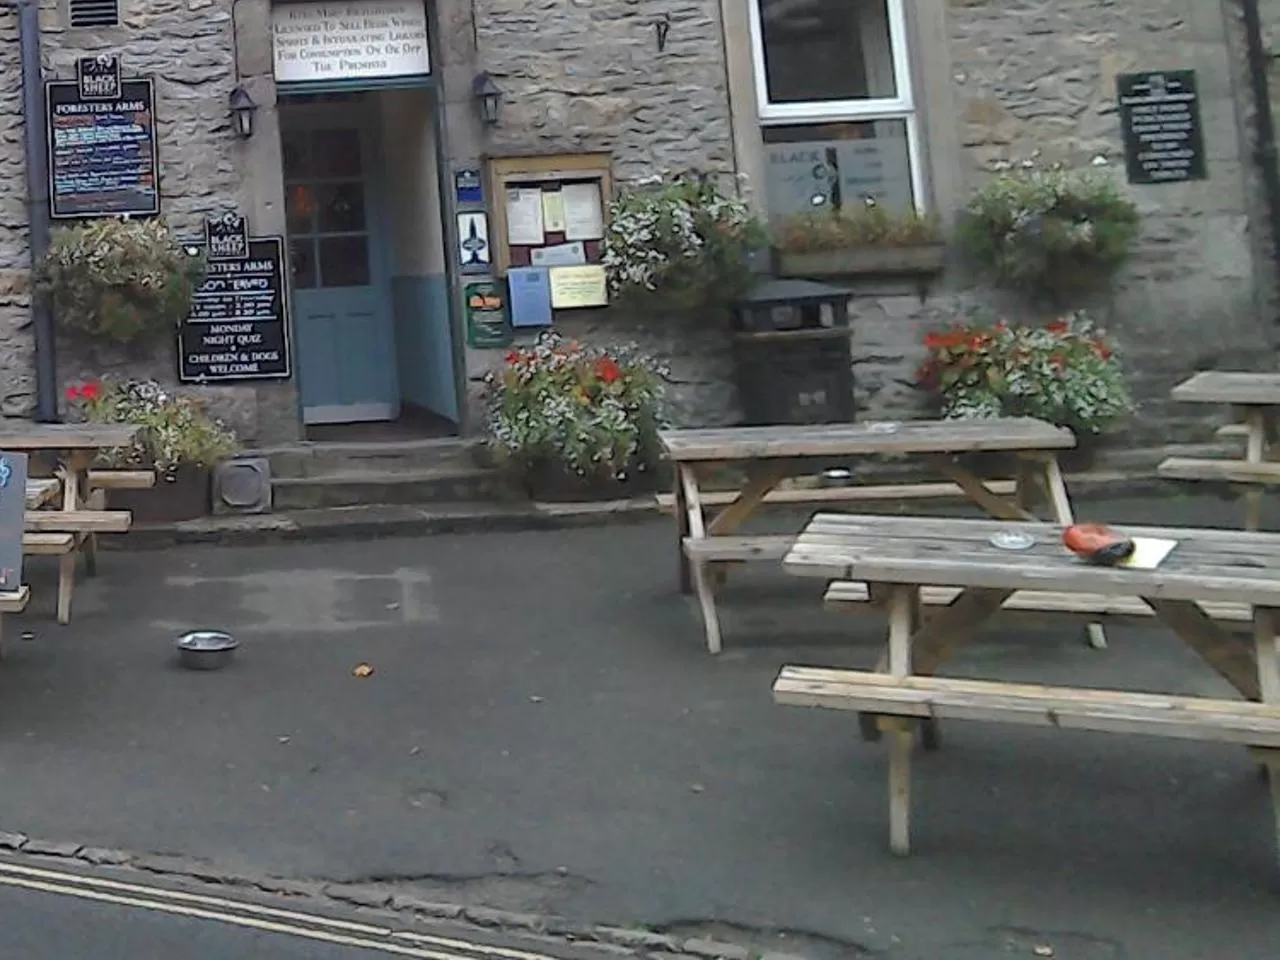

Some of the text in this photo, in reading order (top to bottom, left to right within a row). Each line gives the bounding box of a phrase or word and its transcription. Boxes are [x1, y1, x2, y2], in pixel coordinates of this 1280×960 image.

[56, 100, 144, 115] FORESTERS ARMS
[243, 261, 274, 271] ARMS
[210, 323, 254, 334] MONDAY
[202, 334, 263, 345] NIGHT QUIZ
[189, 352, 238, 363] CHILDREN
[252, 351, 279, 361] DOGS
[209, 363, 259, 373] WELCOME
